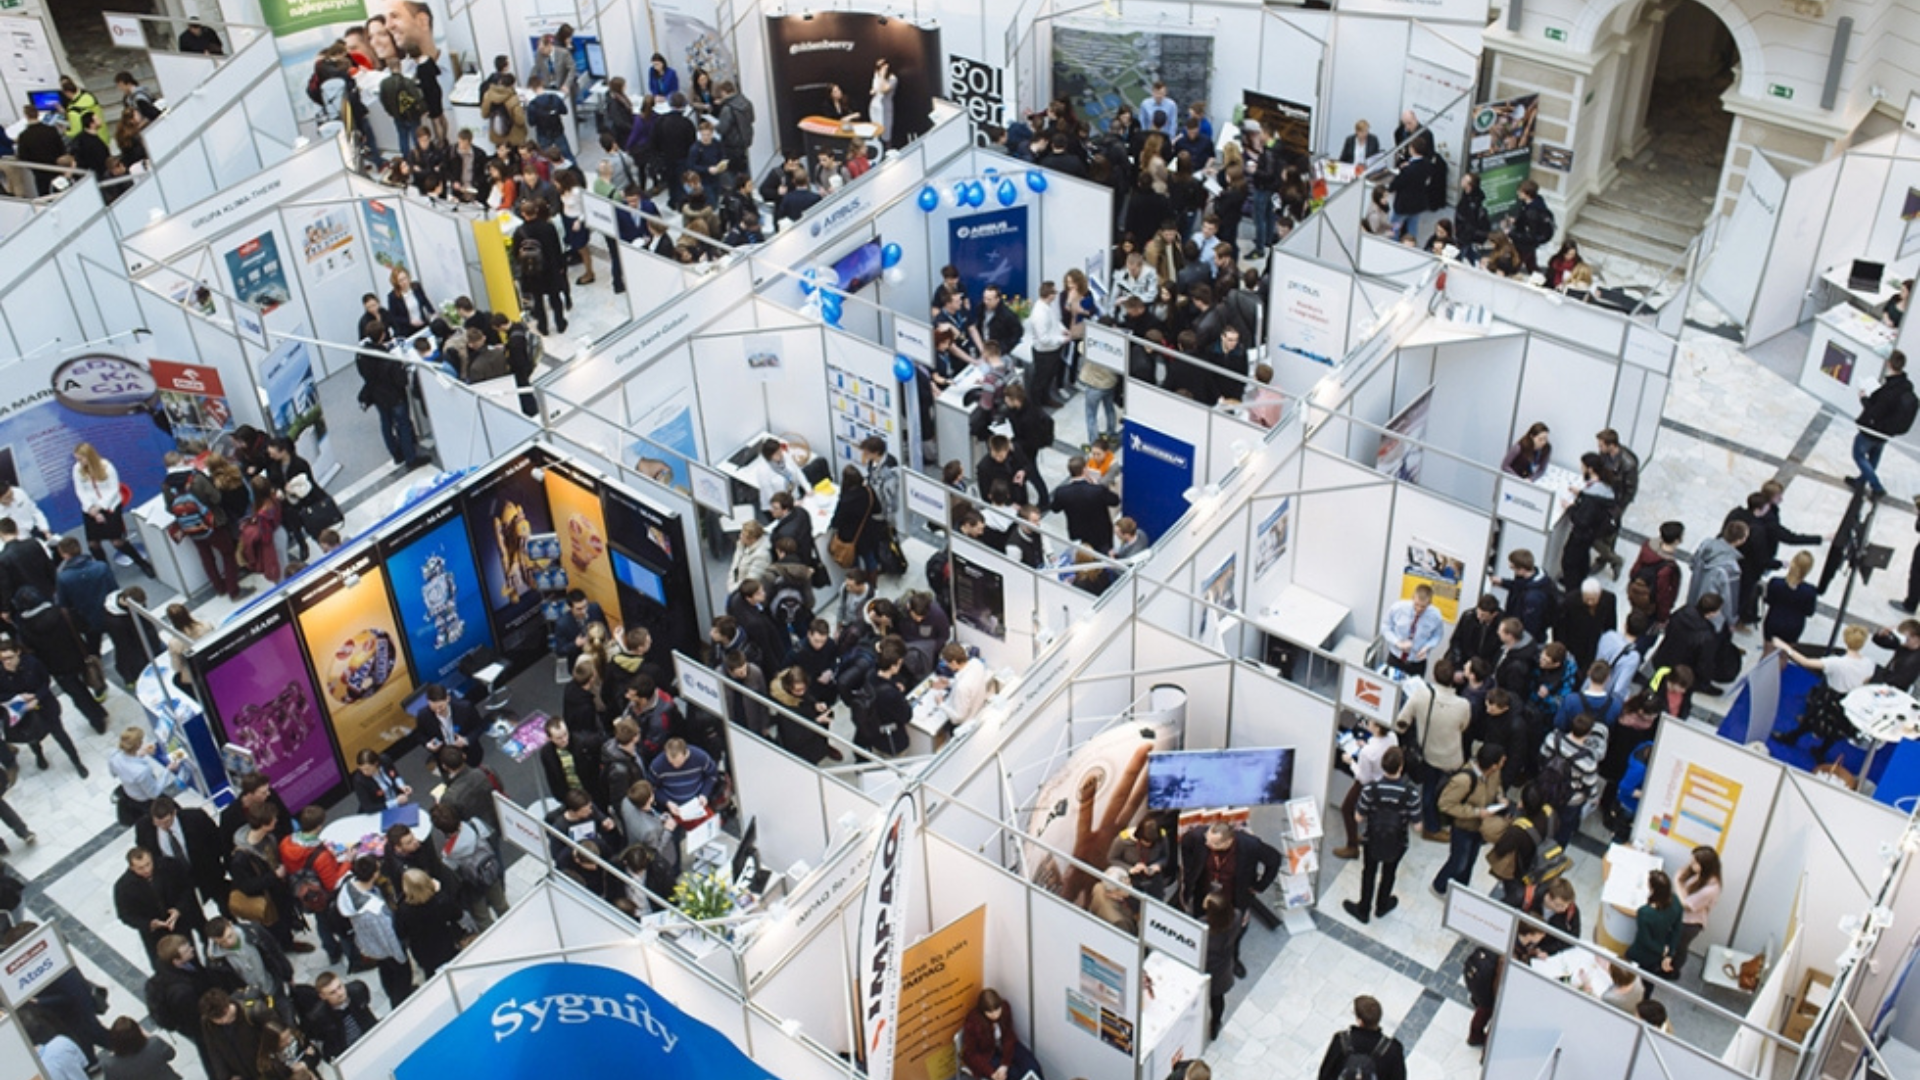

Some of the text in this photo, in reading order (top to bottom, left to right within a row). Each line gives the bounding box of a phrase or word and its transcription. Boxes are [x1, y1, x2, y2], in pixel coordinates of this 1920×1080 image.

[952, 60, 1003, 97] gol
[191, 207, 222, 229] GRUPA
[824, 197, 860, 227] AIRBUS
[970, 221, 1007, 235] AIRBUS
[72, 359, 126, 376] EDU
[99, 372, 139, 382] KA
[90, 381, 145, 394] CJA
[696, 681, 719, 699] esa
[796, 891, 831, 927] IMPAQ
[868, 812, 903, 1021] IMPAQ
[1149, 917, 1197, 950] IMPAQ
[18, 957, 54, 990] Atos
[902, 963, 945, 990] IMPAQ
[490, 992, 679, 1054] Sygnity
